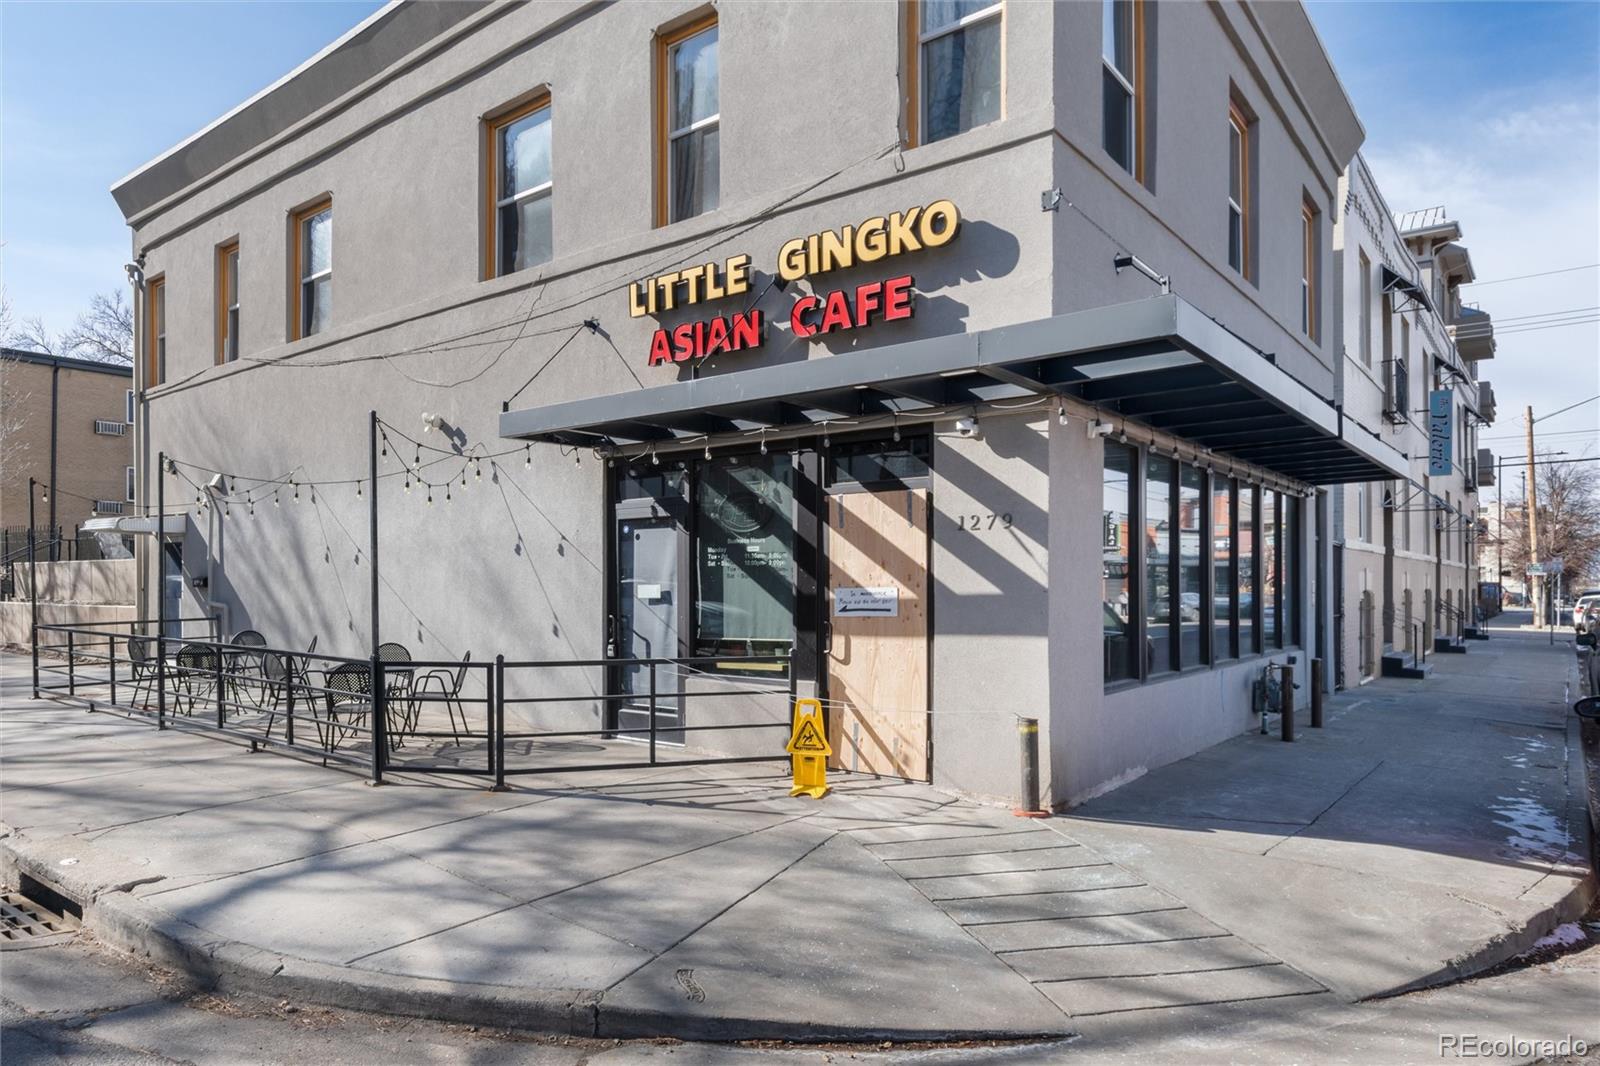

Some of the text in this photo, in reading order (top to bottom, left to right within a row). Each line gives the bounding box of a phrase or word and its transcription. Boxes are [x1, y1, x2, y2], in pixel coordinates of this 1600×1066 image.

[629, 199, 962, 318] LITTLE GINGKO
[648, 275, 915, 367] ASIAN CAFE
[957, 513, 1013, 531] 1279
